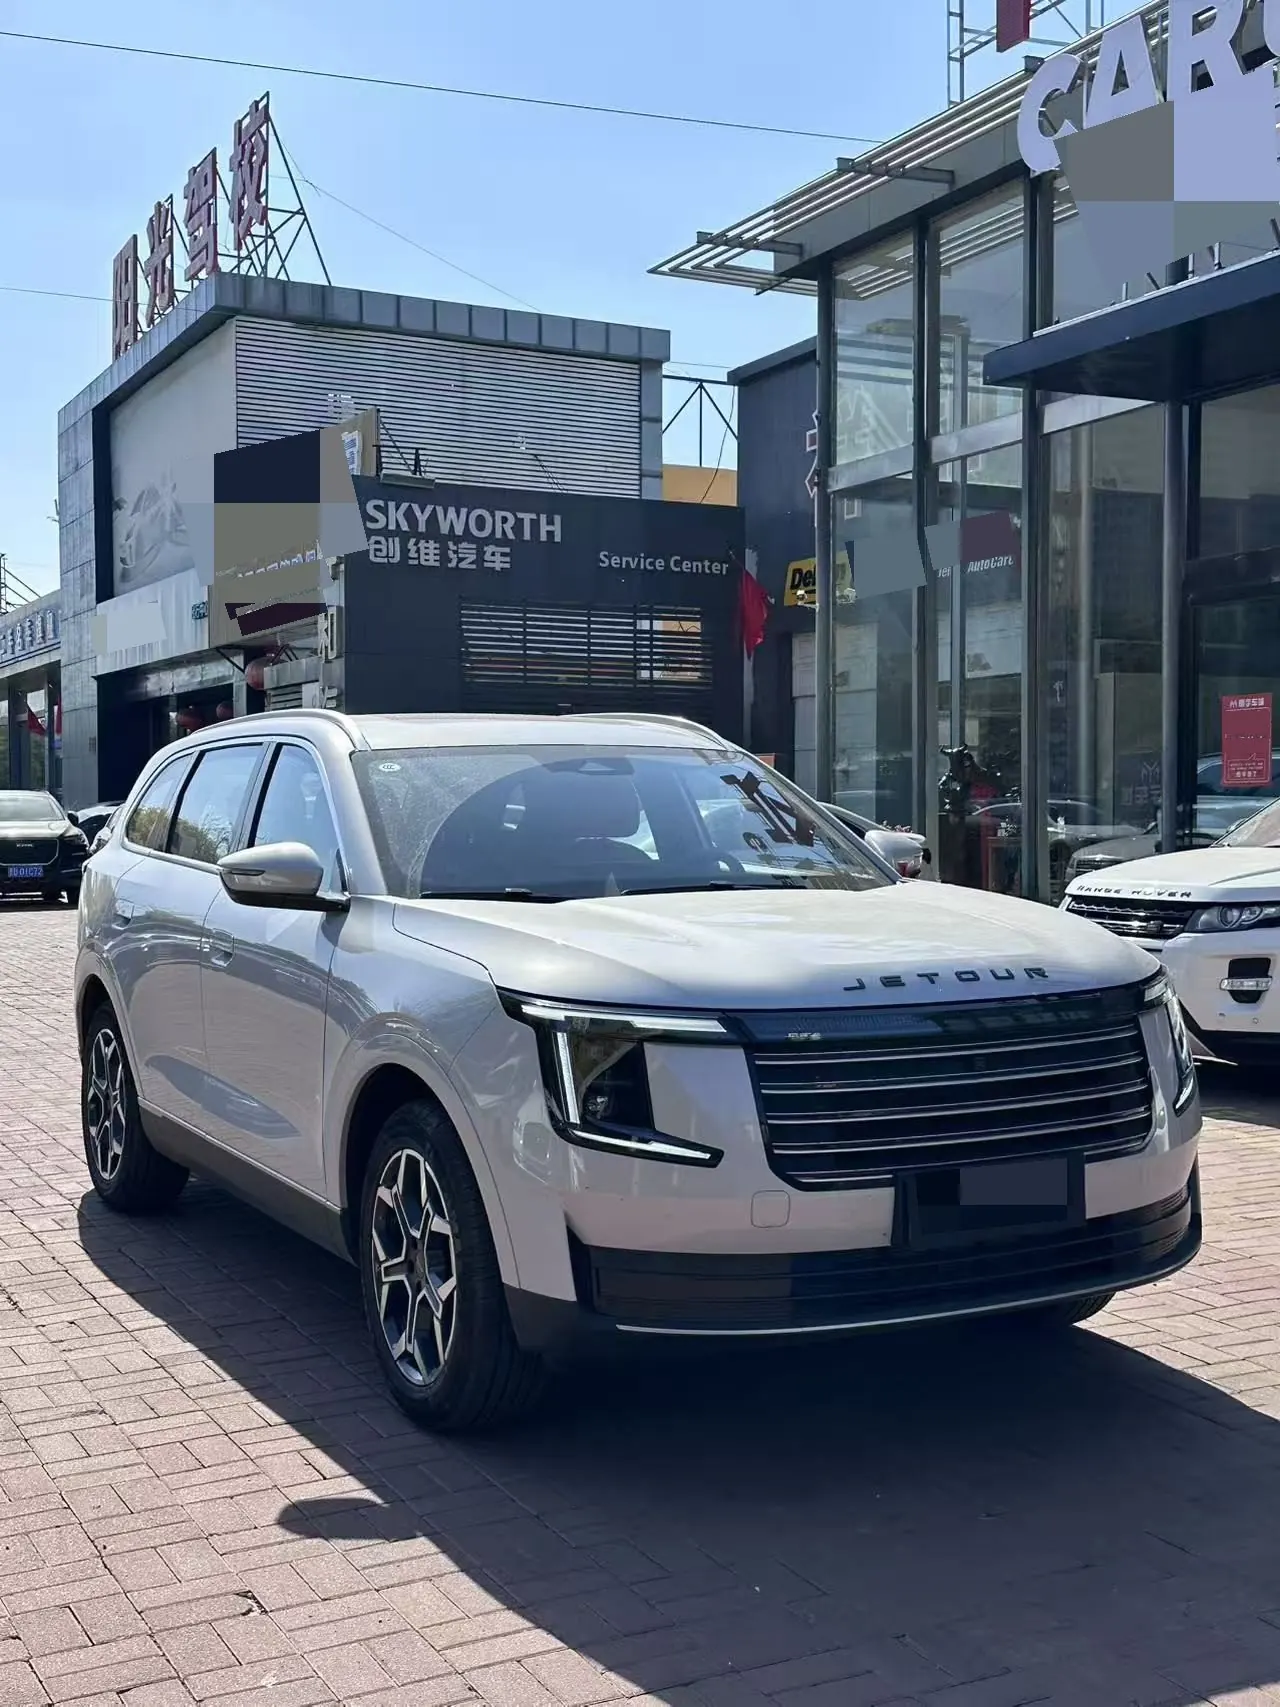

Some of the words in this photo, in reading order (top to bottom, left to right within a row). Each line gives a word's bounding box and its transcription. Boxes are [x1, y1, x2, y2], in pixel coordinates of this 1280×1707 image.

[112, 99, 268, 362] 阳光驾校
[365, 499, 562, 542] SKYWORTH
[368, 535, 511, 571] 创维汽车
[599, 551, 665, 571] Service
[669, 555, 729, 576] Center
[842, 967, 1049, 991] JETOUR
